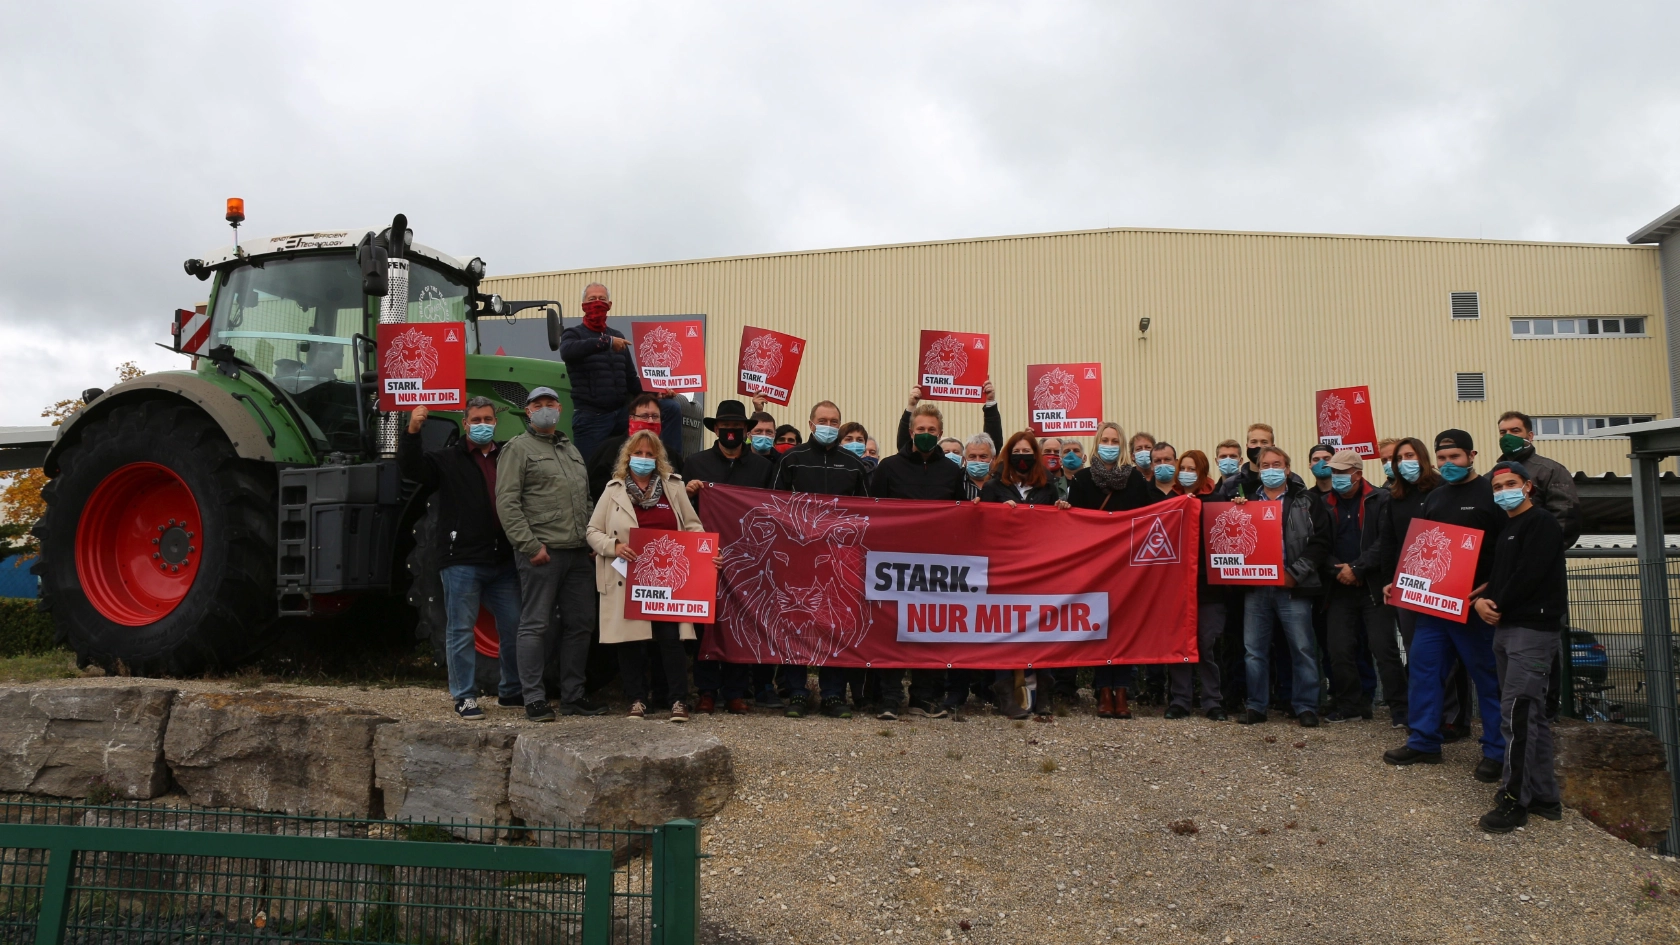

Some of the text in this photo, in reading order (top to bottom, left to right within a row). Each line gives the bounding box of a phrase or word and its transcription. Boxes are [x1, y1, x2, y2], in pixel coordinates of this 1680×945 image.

[388, 261, 409, 271] FEN
[644, 369, 668, 377] STARK.
[743, 372, 764, 383] STARK.
[668, 379, 682, 387] MIT
[684, 377, 700, 385] DIR.
[925, 376, 951, 385] STARK.
[387, 381, 420, 391] STARK.
[747, 382, 786, 399] NUR MIT DIR.
[933, 386, 980, 396] NUR MIT DIR.
[398, 392, 457, 402] NUR MIT DIR.
[1035, 411, 1064, 420] STARK.
[682, 416, 701, 429] FENDT
[1045, 420, 1096, 429] NUR MIT DIR.
[1321, 438, 1341, 446] STARK.
[1354, 445, 1372, 454] DIR.
[1213, 556, 1242, 565] STARK.
[1223, 567, 1276, 576] NUR MIT DIR.
[874, 562, 979, 593] STARK.
[1399, 576, 1427, 591] STARK.
[634, 588, 668, 600] STARK.
[1404, 590, 1460, 612] NUR MIT DIR.
[645, 601, 707, 613] NUR MIT DIR.
[907, 602, 1101, 633] NUR MIT DIR.
